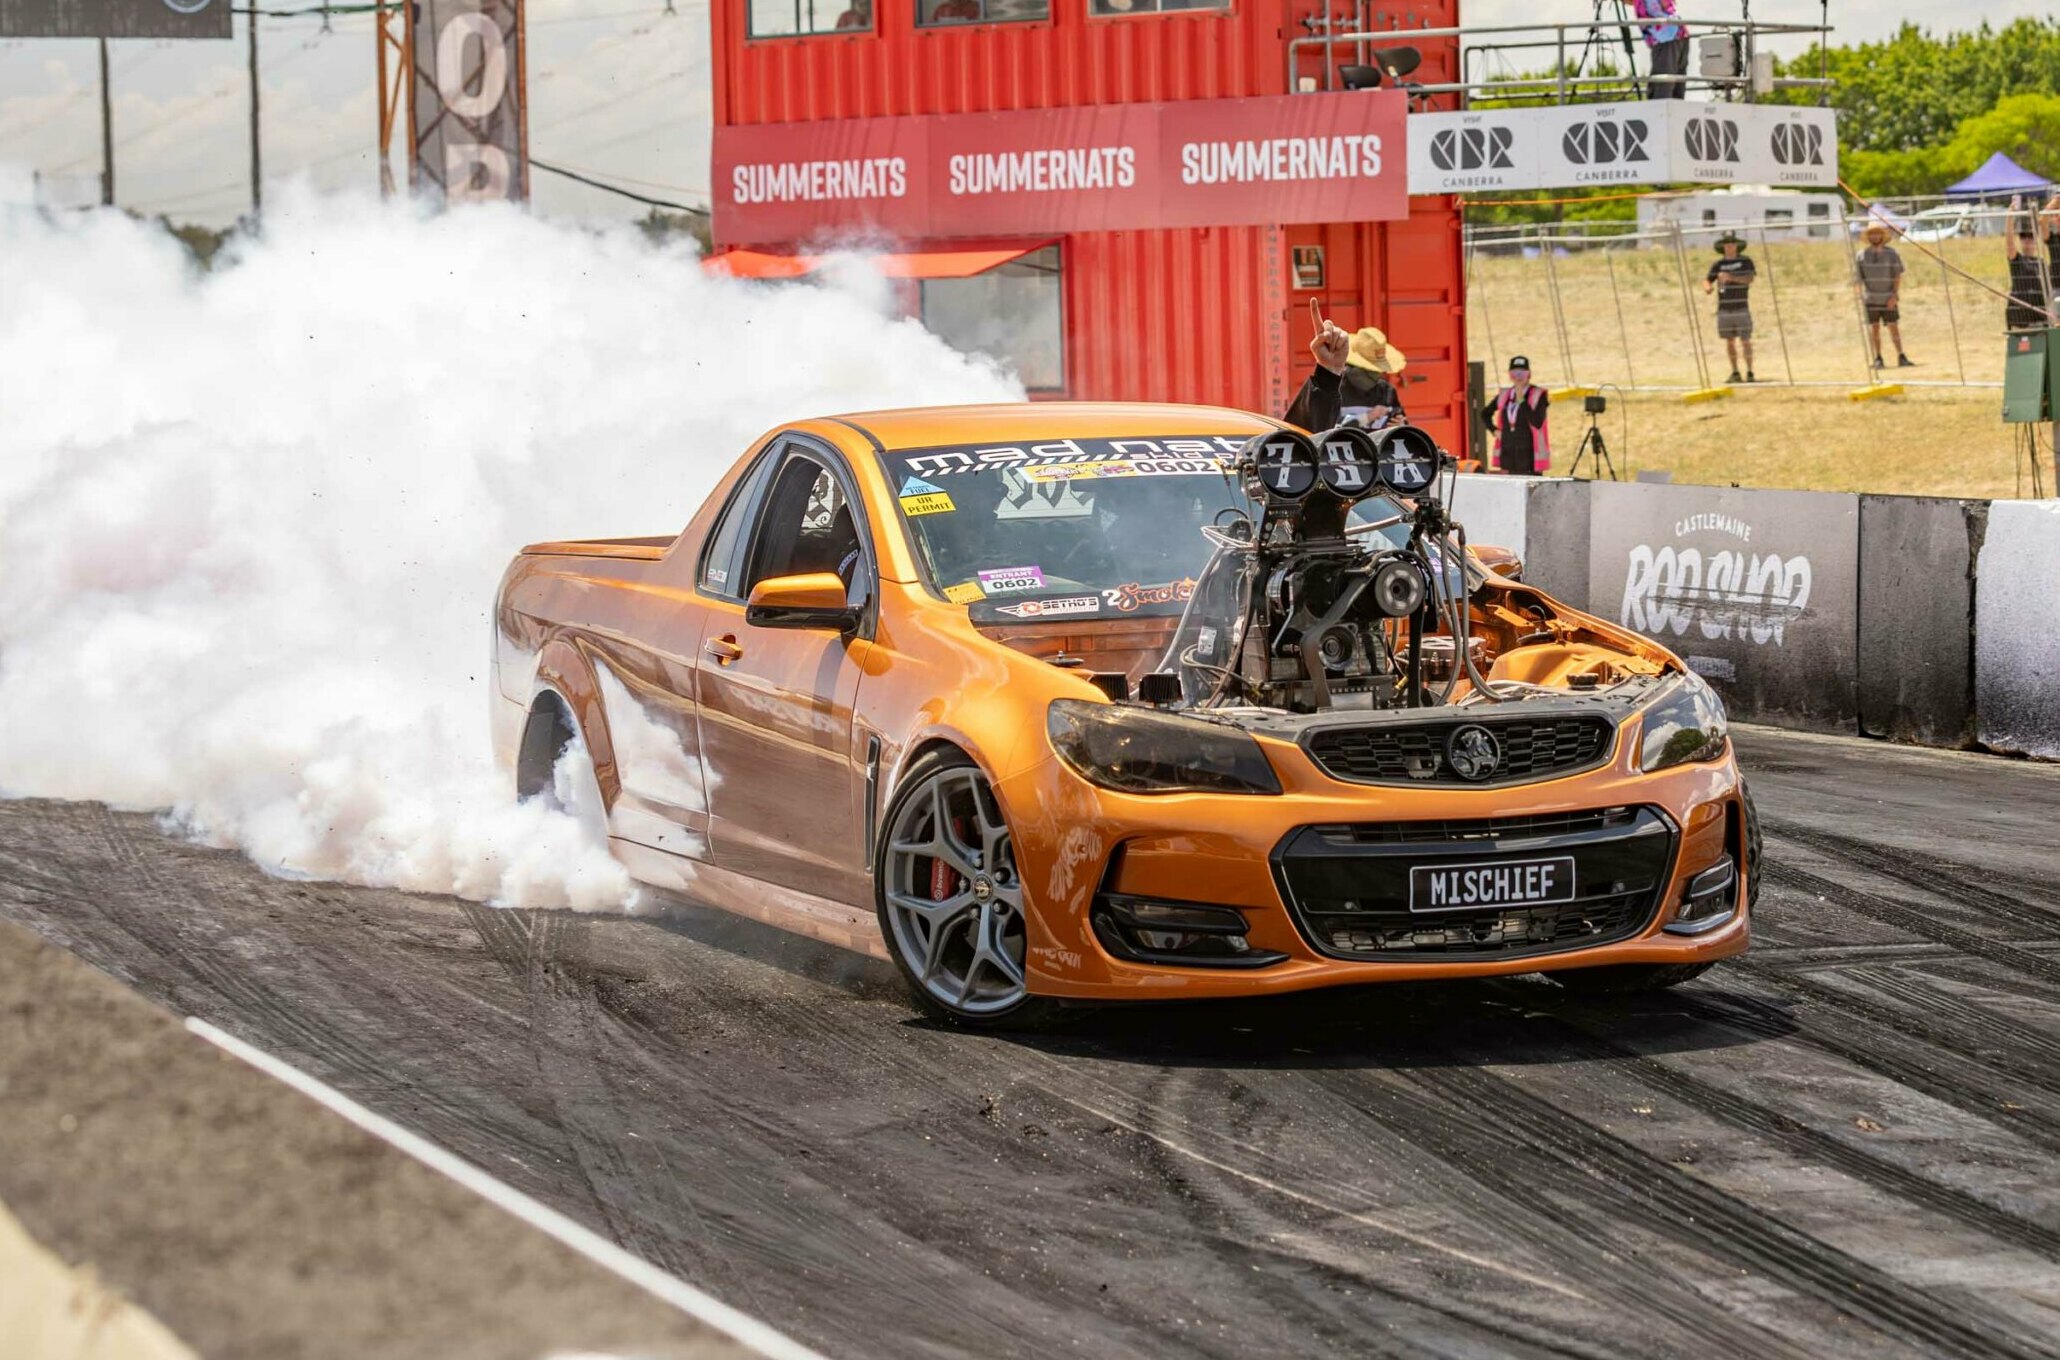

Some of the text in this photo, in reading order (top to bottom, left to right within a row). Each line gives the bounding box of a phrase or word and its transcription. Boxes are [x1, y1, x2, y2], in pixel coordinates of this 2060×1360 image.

[1430, 126, 1516, 171] CBR
[1562, 119, 1651, 165] CBR
[1684, 117, 1741, 162] CBR
[1770, 122, 1825, 165] CBR
[949, 146, 1135, 195] SUMMERNATS
[1181, 134, 1382, 185] SUMMERNATS
[1575, 169, 1639, 182] CANBERRA
[1693, 167, 1735, 179] CANBERRA
[1779, 171, 1819, 182] CANBERRA
[732, 157, 906, 204] SUMMERNATS
[1442, 176, 1504, 188] CANBERRA
[905, 439, 1086, 472] mad
[1109, 436, 1248, 454] nat
[1134, 460, 1218, 474] 0602
[907, 503, 951, 514] PERMIT
[1674, 512, 1752, 543] CASTLEMAINE
[989, 570, 1034, 580] ENTRANT
[992, 578, 1038, 590] 0602
[1620, 544, 1812, 648] ROD SHOP
[1430, 864, 1555, 906] MISCHIEF
